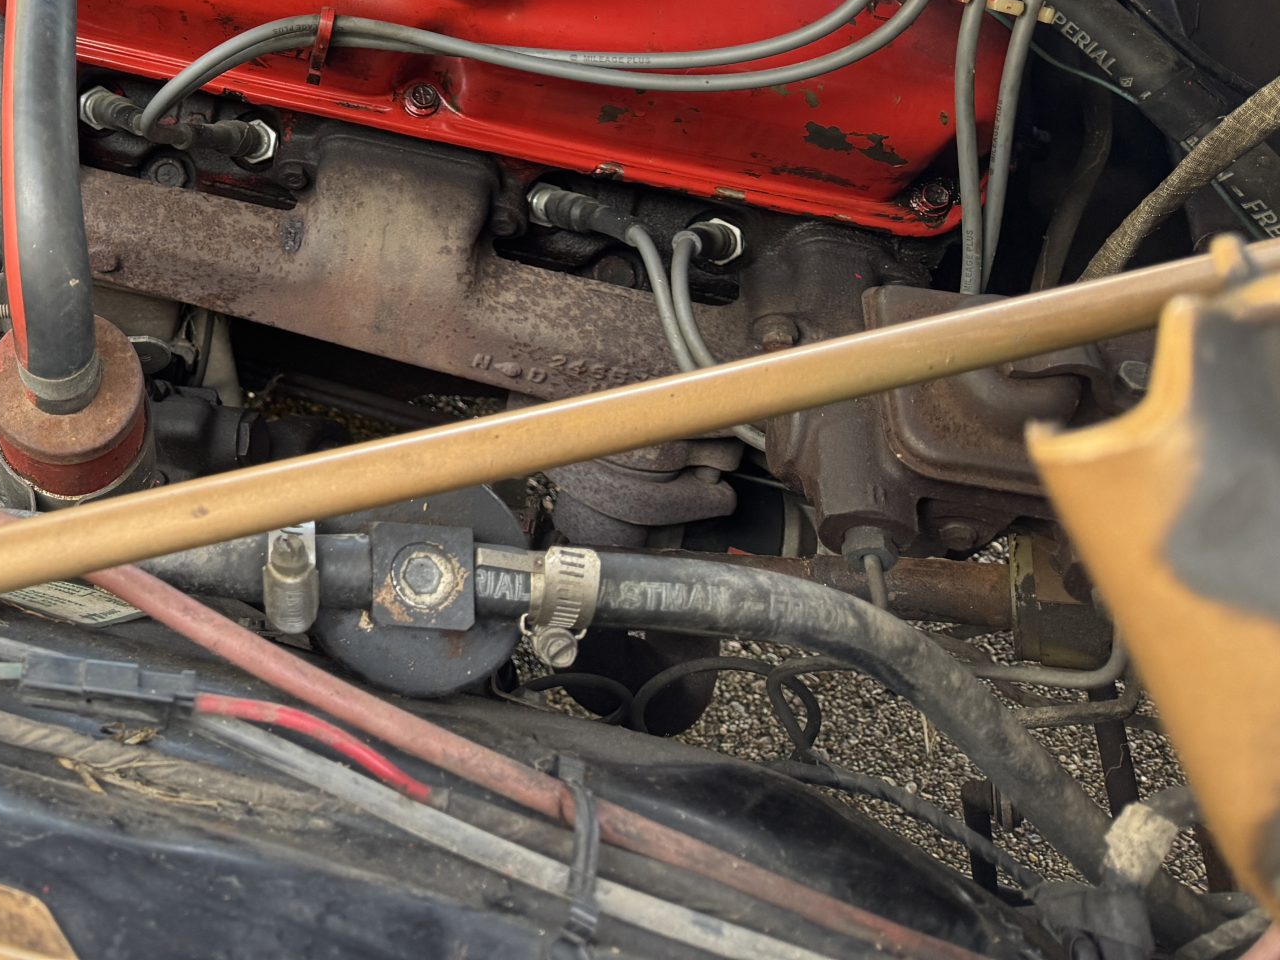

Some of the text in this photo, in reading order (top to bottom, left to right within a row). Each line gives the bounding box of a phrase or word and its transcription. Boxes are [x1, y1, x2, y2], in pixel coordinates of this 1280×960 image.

[582, 53, 652, 66] MILEAGE PLUS
[1052, 10, 1117, 76] PERIAL
[597, 575, 728, 618] ASTMAN
